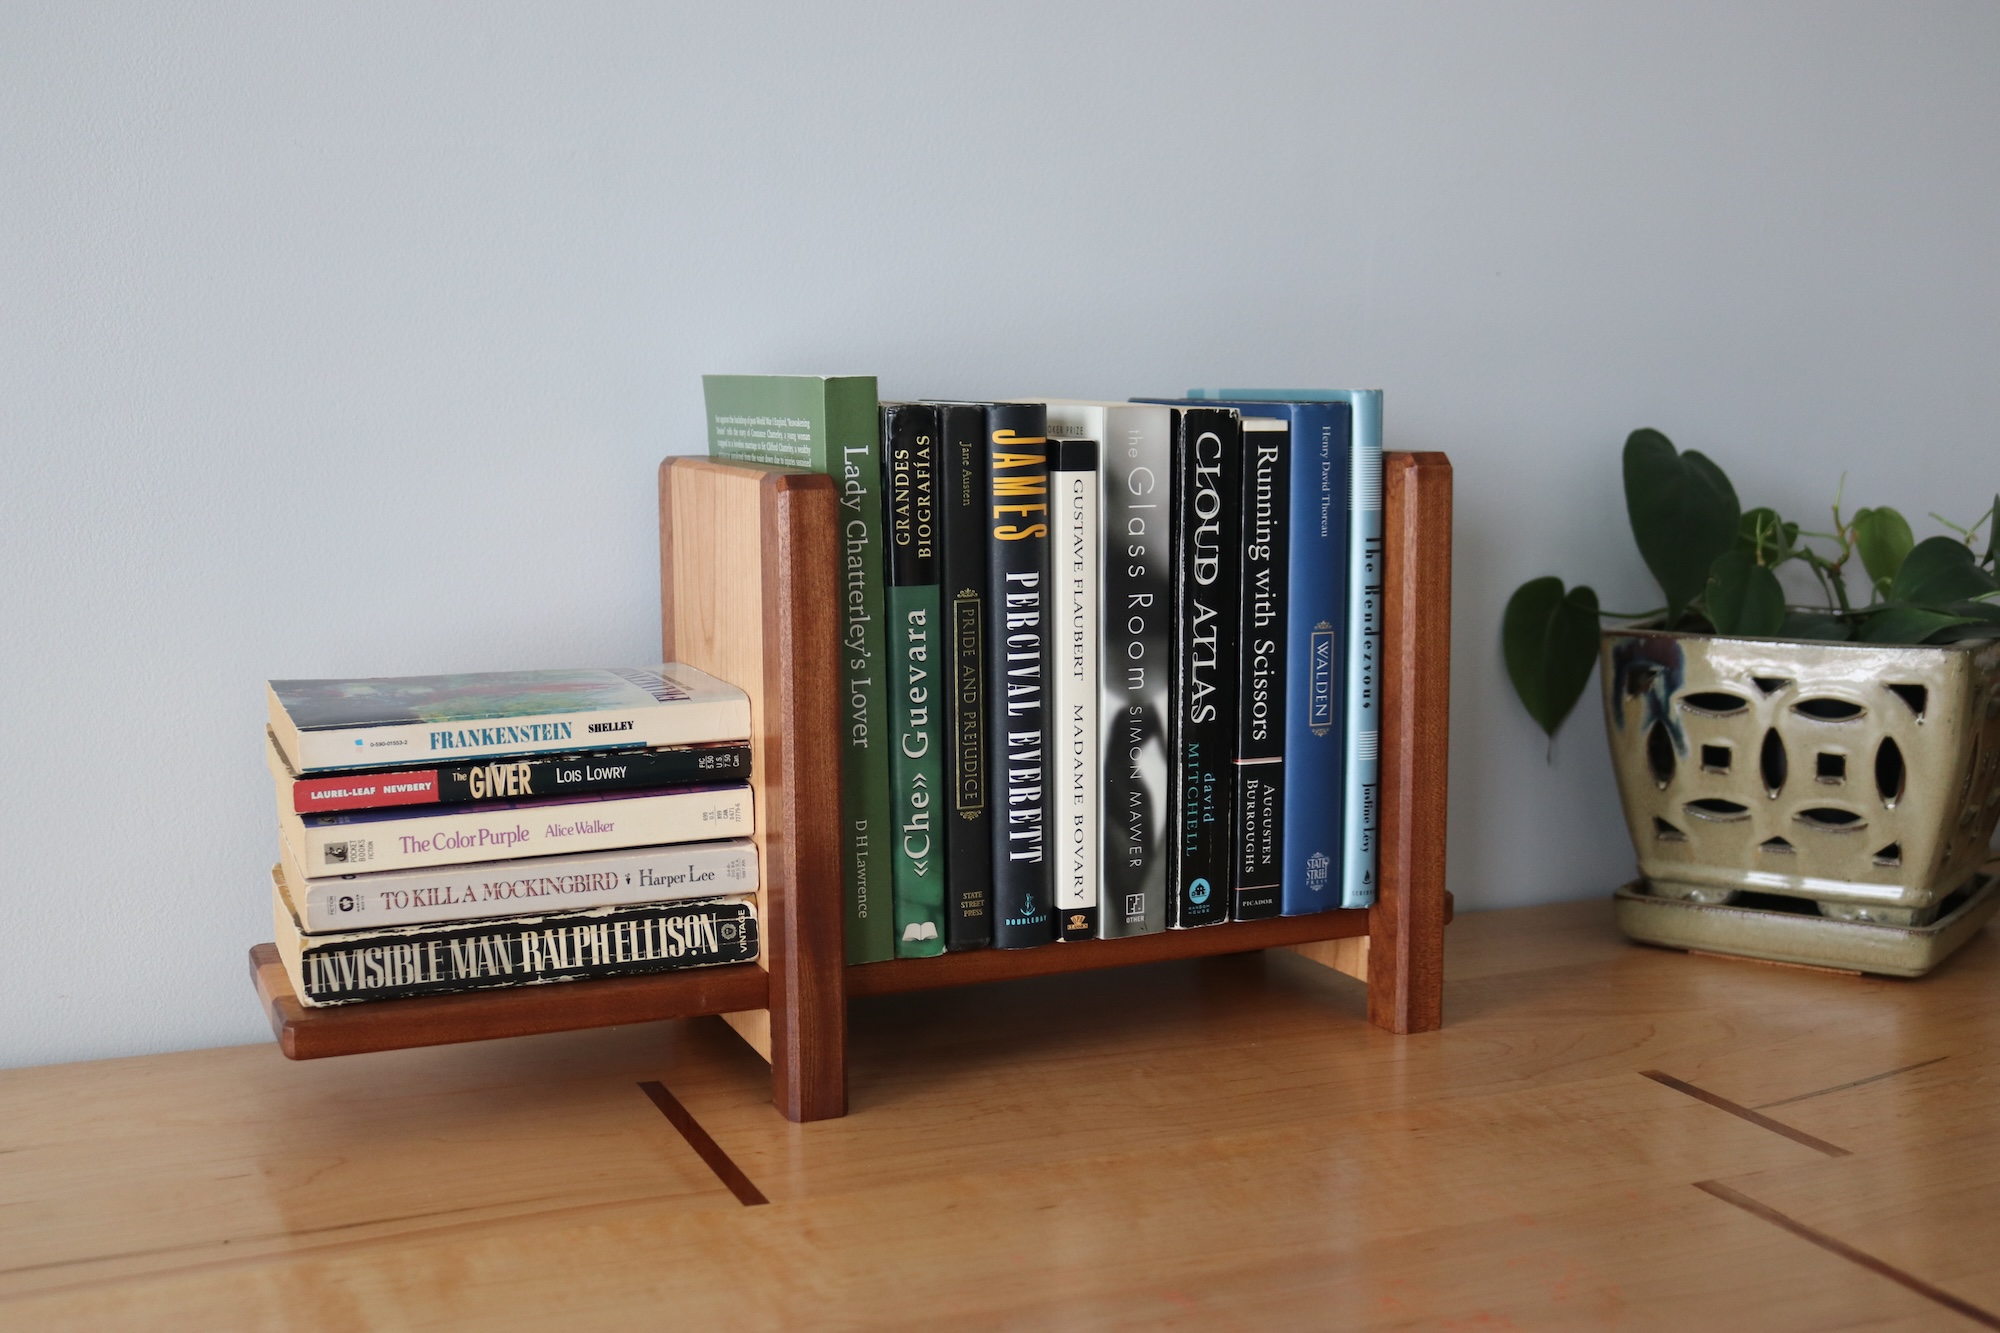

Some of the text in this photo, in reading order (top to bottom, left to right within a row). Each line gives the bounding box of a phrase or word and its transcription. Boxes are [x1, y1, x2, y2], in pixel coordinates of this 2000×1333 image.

[895, 449, 910, 546] GRANDES
[913, 435, 931, 558] BIOGRAFÍAS
[959, 441, 973, 507] Jane Austen
[992, 429, 1048, 541] JAMES
[1320, 426, 1331, 537] Henry David Thoreau
[1128, 430, 1157, 689] the Glass Room
[1190, 431, 1222, 724] CLOUD ATLAS
[840, 445, 871, 748] Lady Chatterley's Lover
[1247, 445, 1278, 741] Running with Scissors
[1362, 585, 1380, 709] Rendezvous
[962, 609, 978, 800] PRIDE AND PREJUDICE
[1073, 479, 1084, 900] GUSTAVE FLAUBERT MADAME BOVARY
[1315, 641, 1329, 717] WALDEN
[429, 721, 573, 750] FRANKENSTEIN
[588, 720, 635, 733] SHELLEY
[902, 608, 931, 878] «Che» Guevara
[1005, 571, 1043, 863] PERCIVAL EVERETT
[311, 782, 432, 800] LAUREL-LEAF NEWBERY
[452, 763, 533, 799] The GIVER
[555, 765, 627, 784] LOIS LOWRY
[1129, 706, 1143, 868] SIMON MAWER
[1186, 742, 1200, 857] MITCHELL
[1203, 772, 1216, 822] david
[1362, 783, 1377, 823] Justine
[349, 839, 358, 863] POCKET
[358, 838, 366, 862] BOOKS
[399, 824, 530, 854] The Color Purple
[545, 820, 615, 839] Alice Walker
[1245, 779, 1258, 873] BURROUGHS
[1262, 784, 1275, 865] AUGUSTEN
[380, 871, 619, 910] TO KILL A MOCKINGBIRD
[639, 868, 686, 888] Harper
[688, 865, 715, 882] Lee
[857, 851, 868, 918] Lawrence
[1306, 857, 1326, 869] STATE
[1306, 868, 1328, 881] STREET
[960, 900, 985, 908] STREET
[962, 890, 982, 899] STATE
[964, 909, 983, 917] PRESS
[1005, 915, 1047, 926] DOUBLEDAY
[1125, 914, 1145, 923] OTHER
[1242, 899, 1273, 907] PICADOR
[520, 911, 719, 974] RALPH ELLISON
[738, 909, 747, 954] VINTAGE
[308, 933, 514, 995] INVISIBLE MAN
